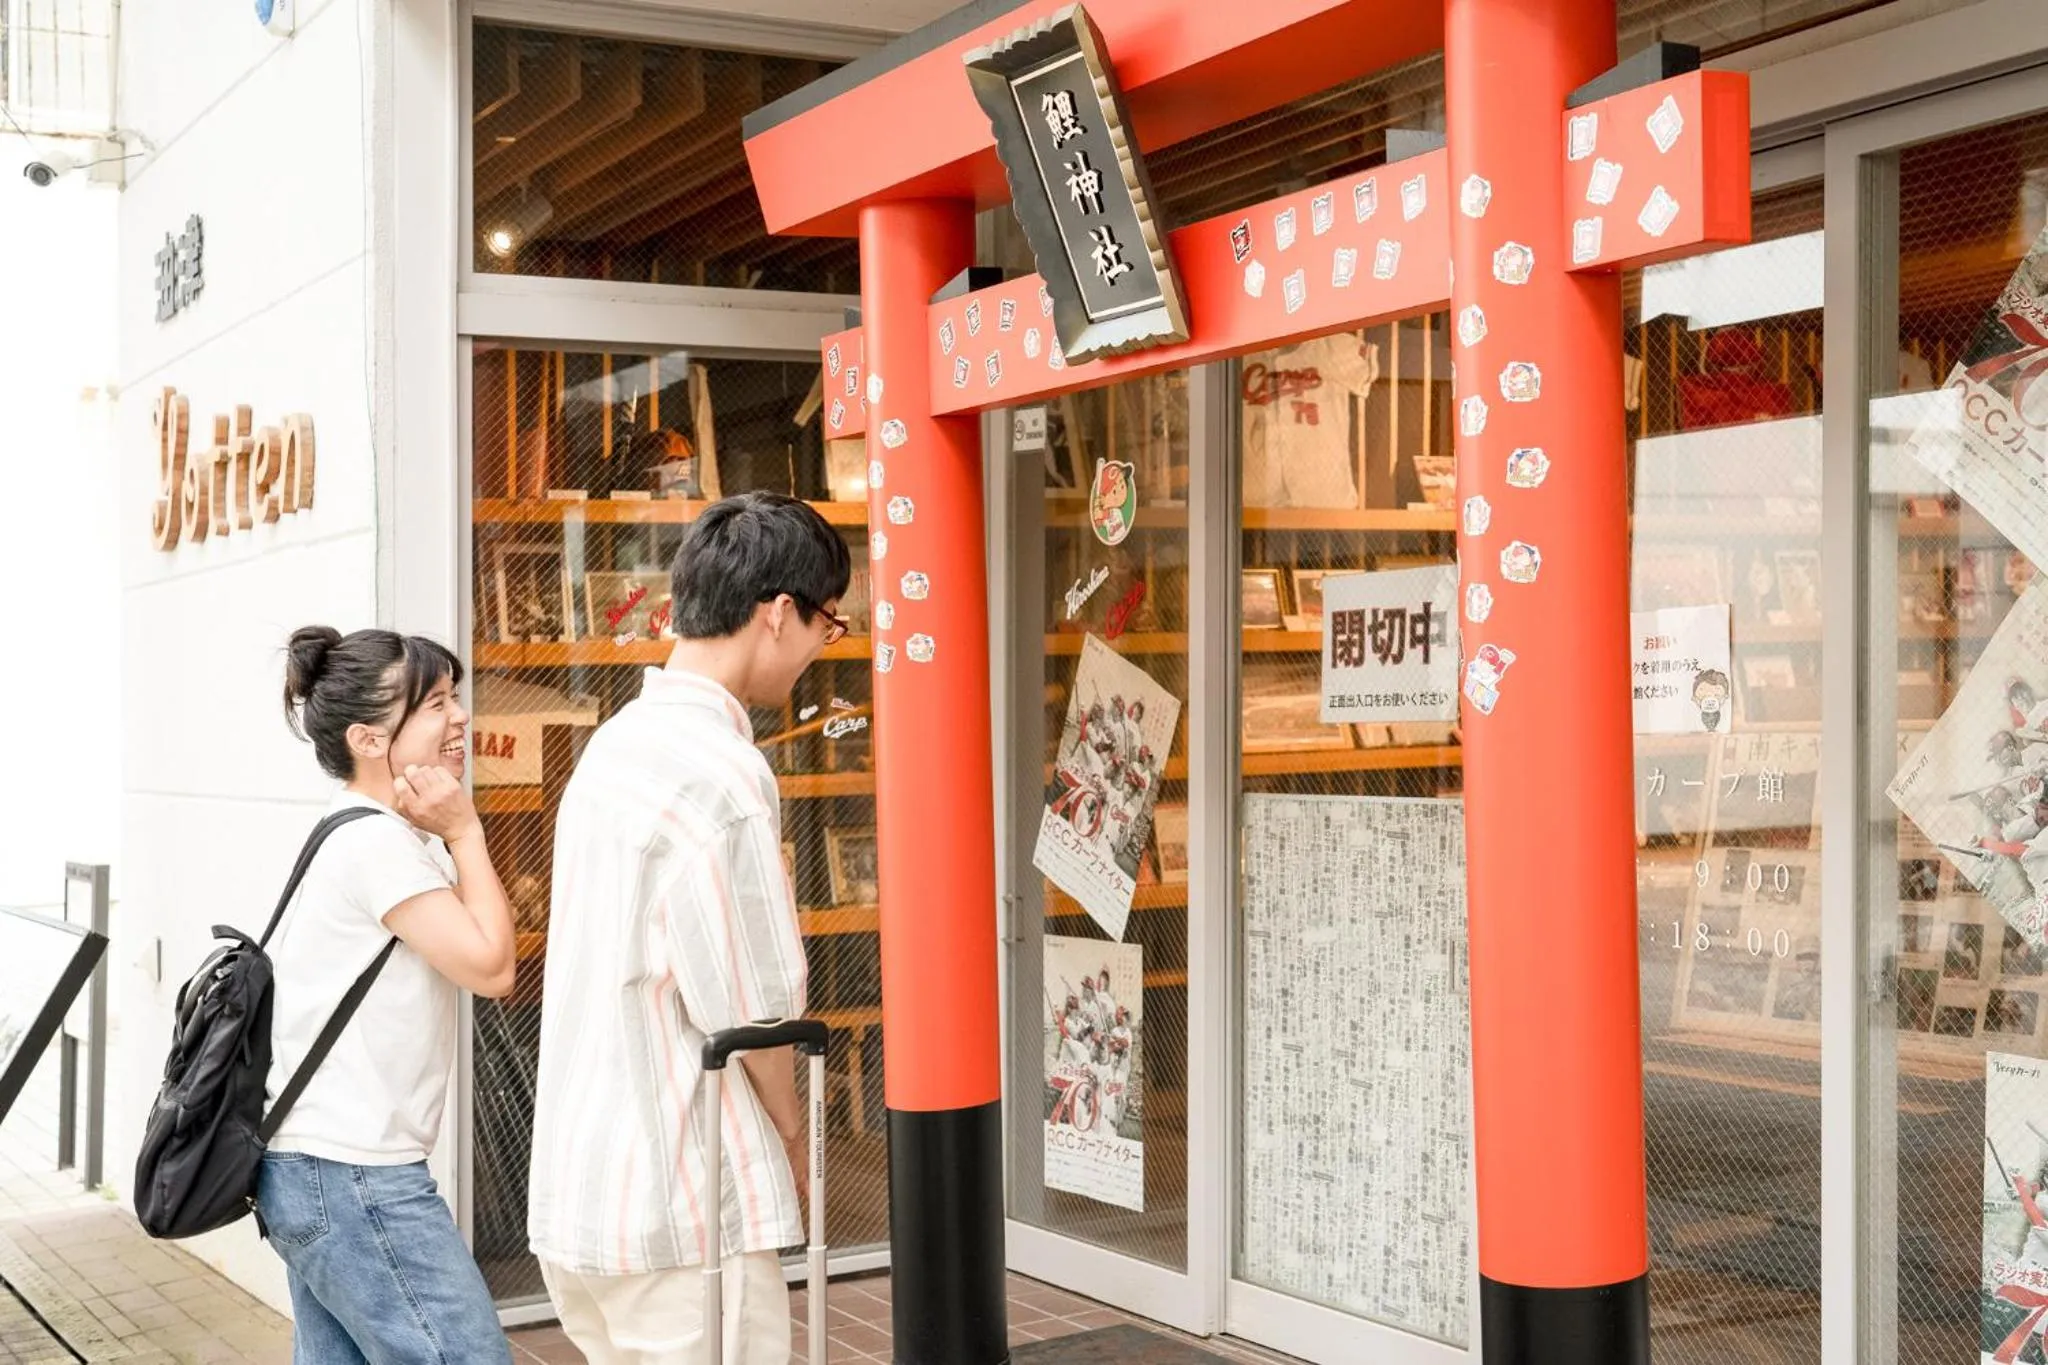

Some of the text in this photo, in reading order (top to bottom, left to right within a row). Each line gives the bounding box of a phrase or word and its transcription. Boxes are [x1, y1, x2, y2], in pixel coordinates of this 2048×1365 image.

[1041, 89, 1134, 288] 鯉神社
[151, 385, 316, 553] Yotten
[1331, 601, 1448, 669] 閉切中
[1329, 692, 1448, 709] 正面出入口をお使いください
[823, 716, 868, 739] Carp
[1647, 767, 1786, 803] カープ館
[1695, 859, 1790, 893] 9:00
[815, 1100, 824, 1139] AMERICAN
[1049, 1075, 1098, 1132] 70
